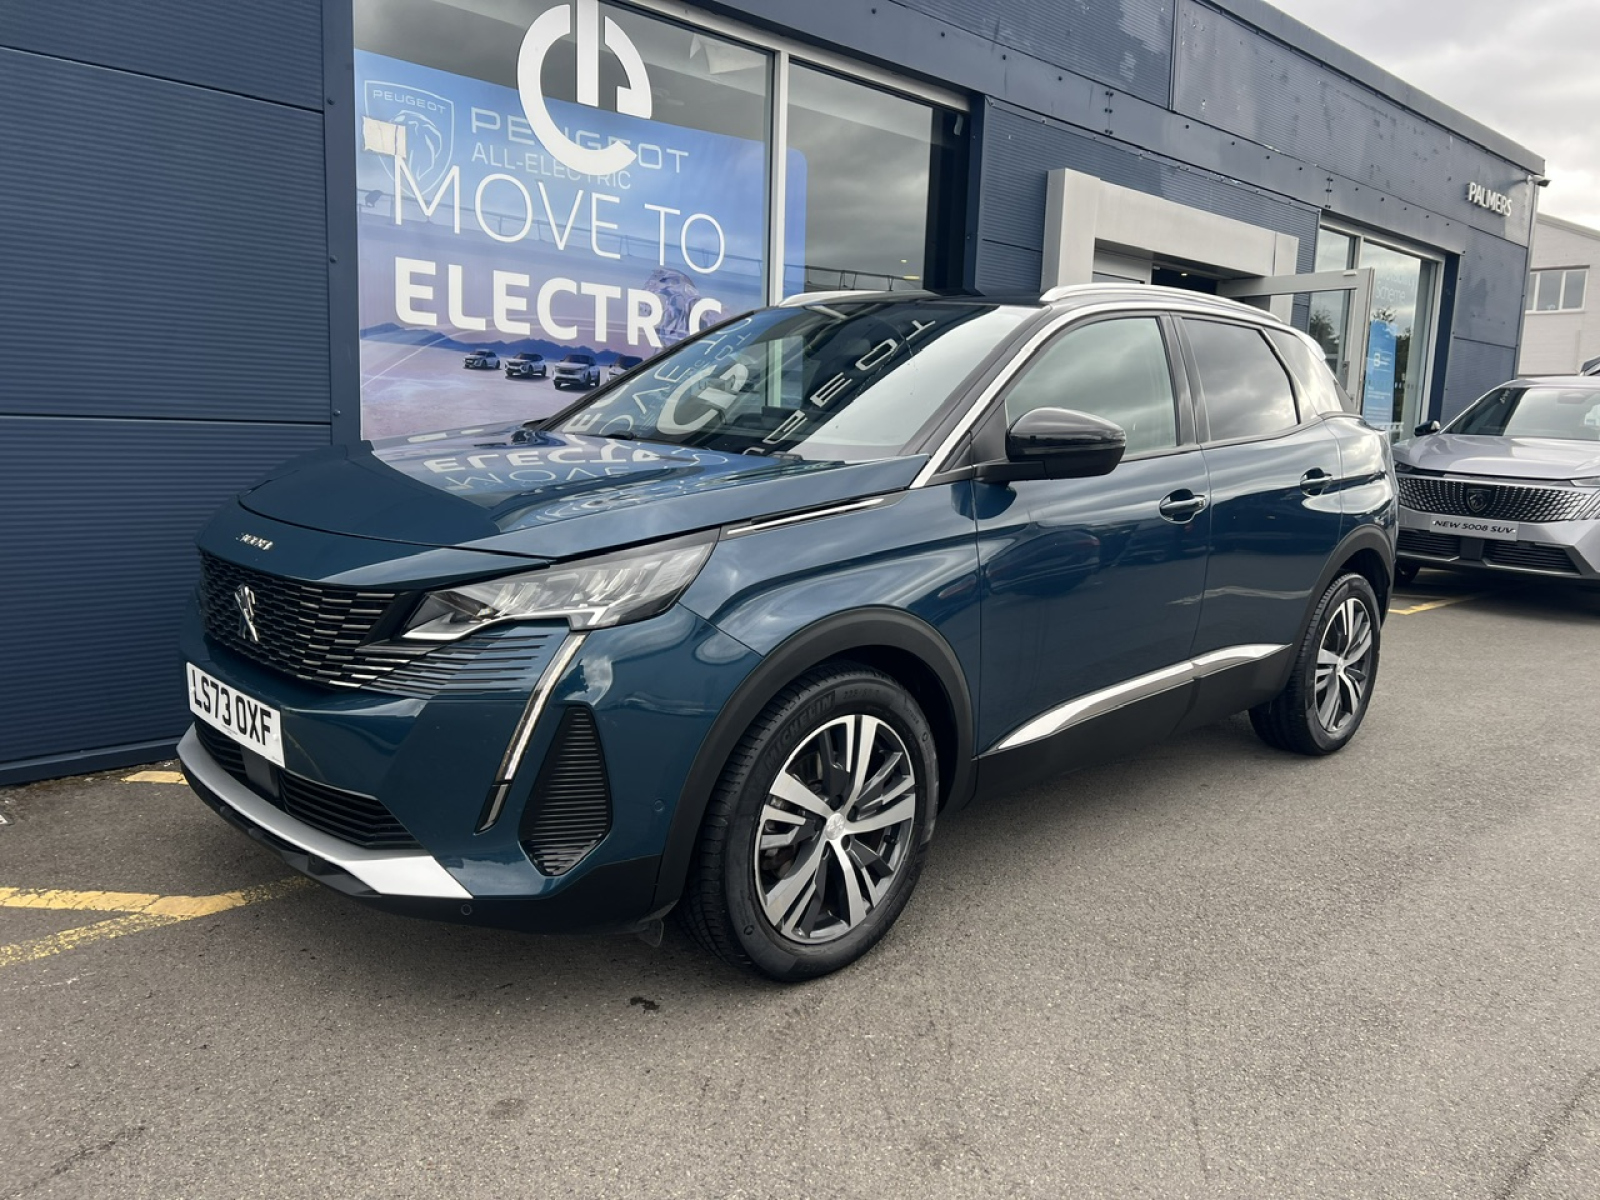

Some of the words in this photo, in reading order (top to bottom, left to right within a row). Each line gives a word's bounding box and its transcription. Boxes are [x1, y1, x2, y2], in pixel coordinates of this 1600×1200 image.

[373, 89, 446, 115] PEUGEOT
[470, 106, 690, 174] PEGOT
[394, 154, 621, 260] MOVE
[644, 203, 726, 274] TO
[1468, 182, 1512, 216] PALMERS
[394, 256, 722, 348] ELECTRC
[1434, 520, 1461, 528] NEW
[1462, 522, 1488, 531] 5008
[1490, 525, 1514, 534] SUV
[192, 669, 231, 726] LS73
[235, 694, 272, 746] OXF
[764, 693, 834, 770] MICHELIN
